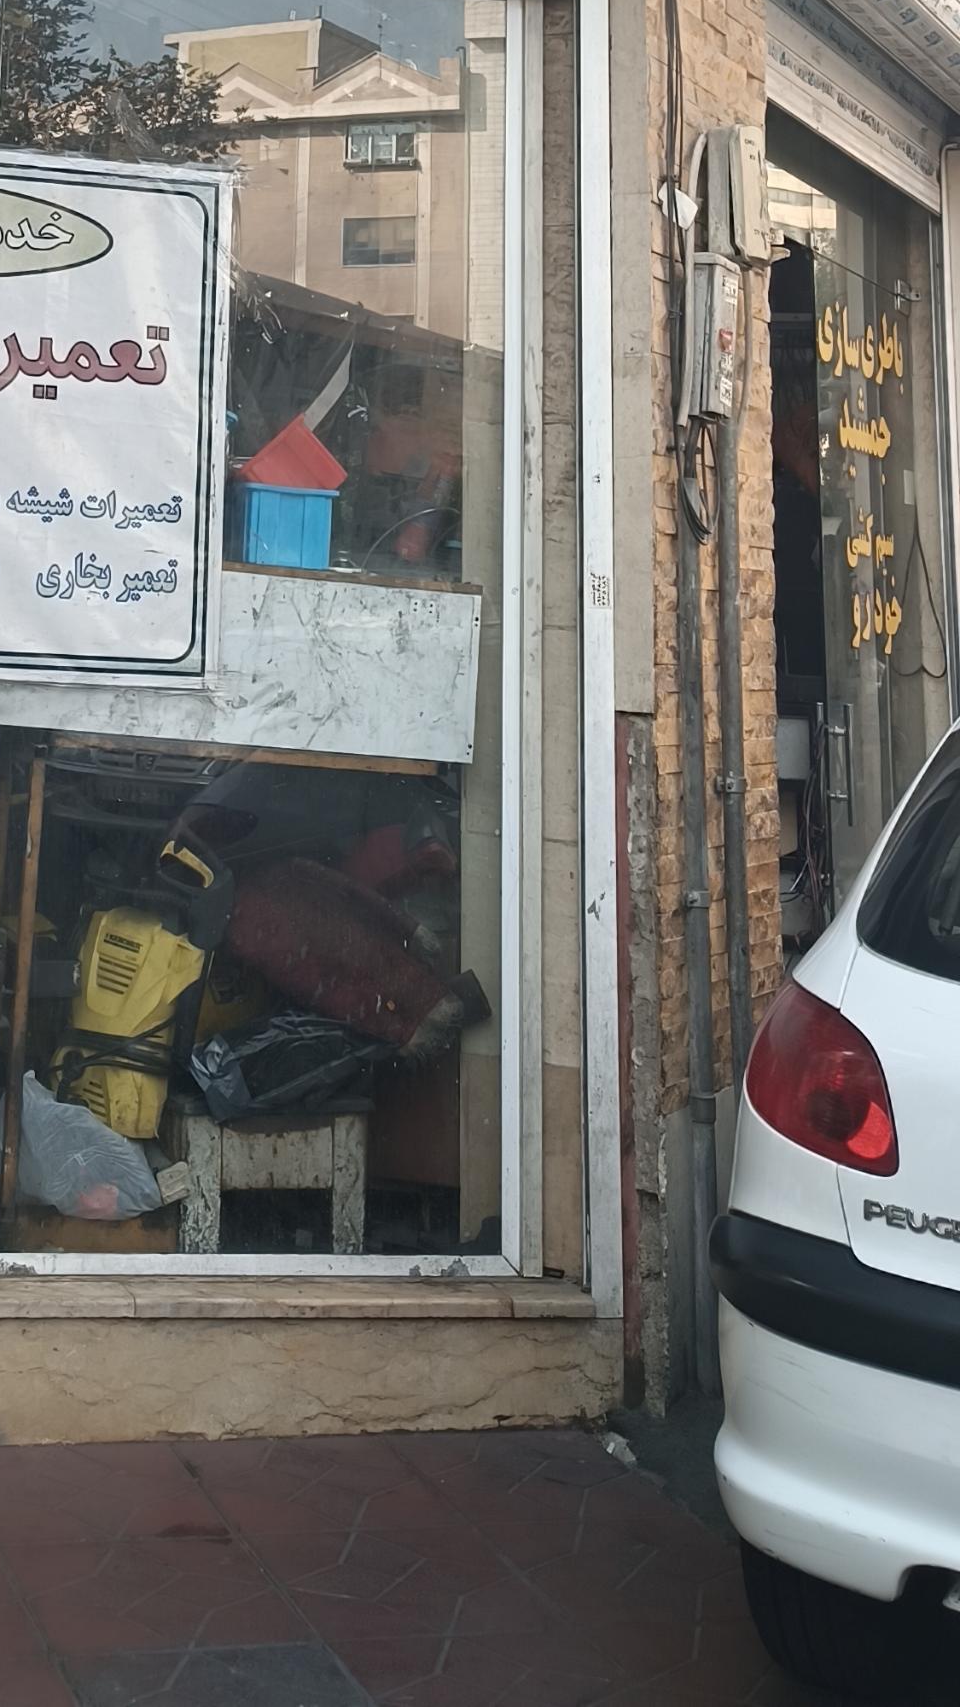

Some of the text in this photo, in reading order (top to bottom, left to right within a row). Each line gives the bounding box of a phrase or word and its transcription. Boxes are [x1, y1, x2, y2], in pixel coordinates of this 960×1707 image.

[6, 485, 74, 523] شیشه
[79, 489, 183, 530] تعمیرات
[35, 552, 178, 603] تعمیر بخاری
[863, 1198, 960, 1243] PEUG
